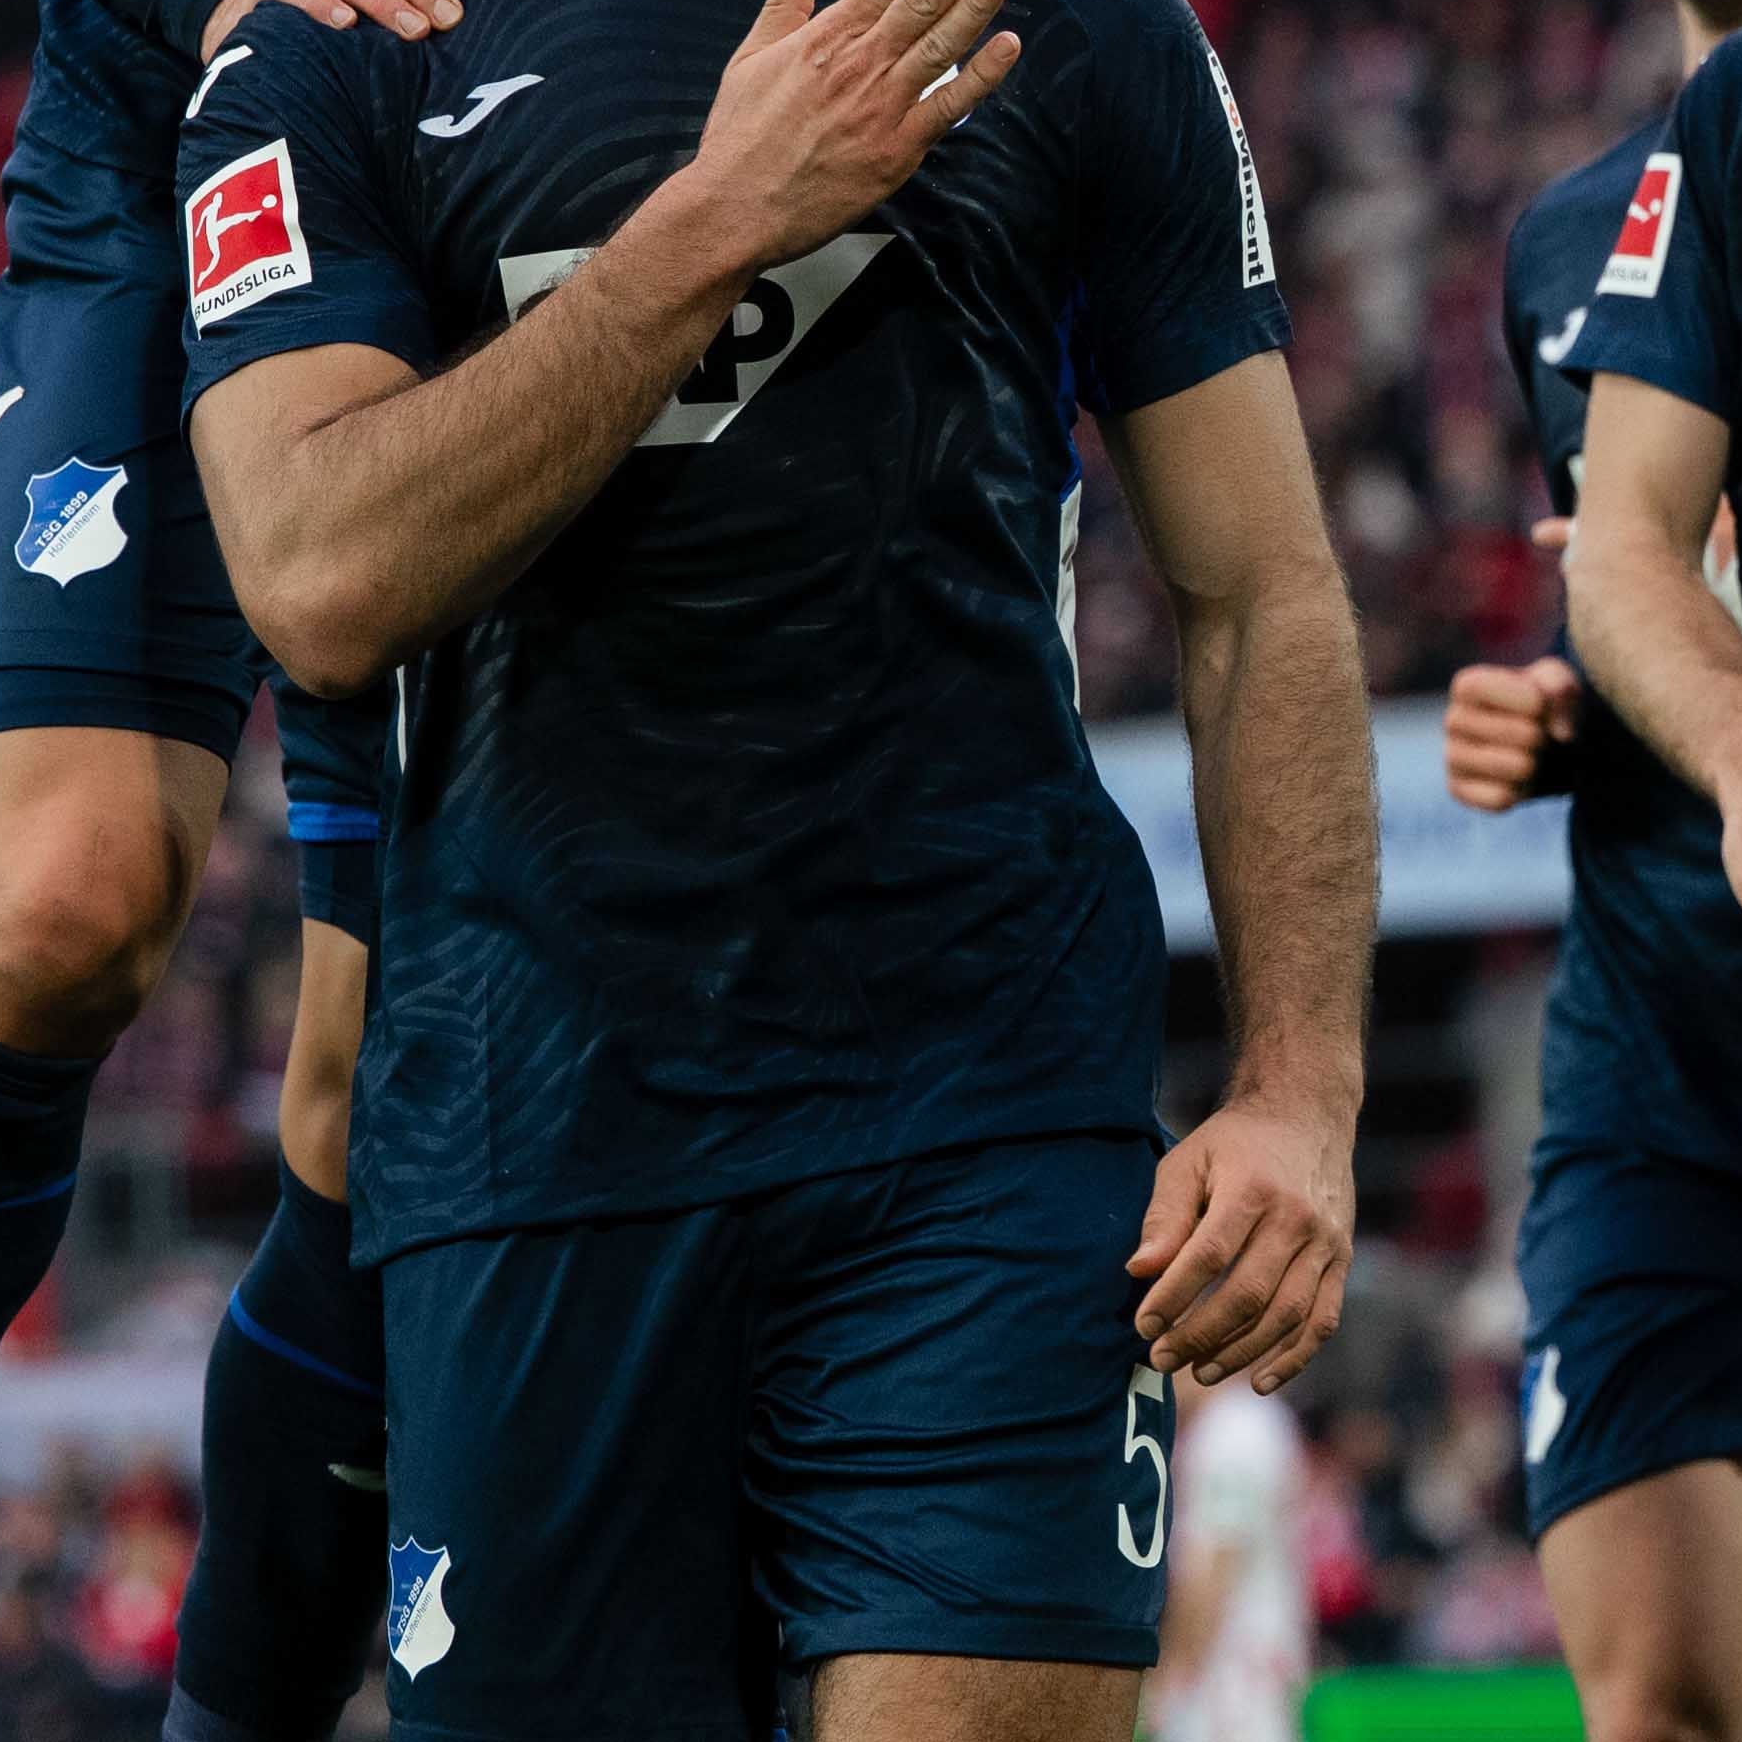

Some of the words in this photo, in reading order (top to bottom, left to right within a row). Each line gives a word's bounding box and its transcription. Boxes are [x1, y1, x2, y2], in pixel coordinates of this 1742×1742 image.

[194, 262, 297, 320] BUNDESLIGA
[34, 519, 63, 548] TSG
[59, 489, 89, 520] 1899
[48, 502, 100, 559] Hoffenheim
[1117, 1361, 1168, 1569] 5
[397, 1604, 411, 1634] TSG
[407, 1575, 425, 1605] 1899
